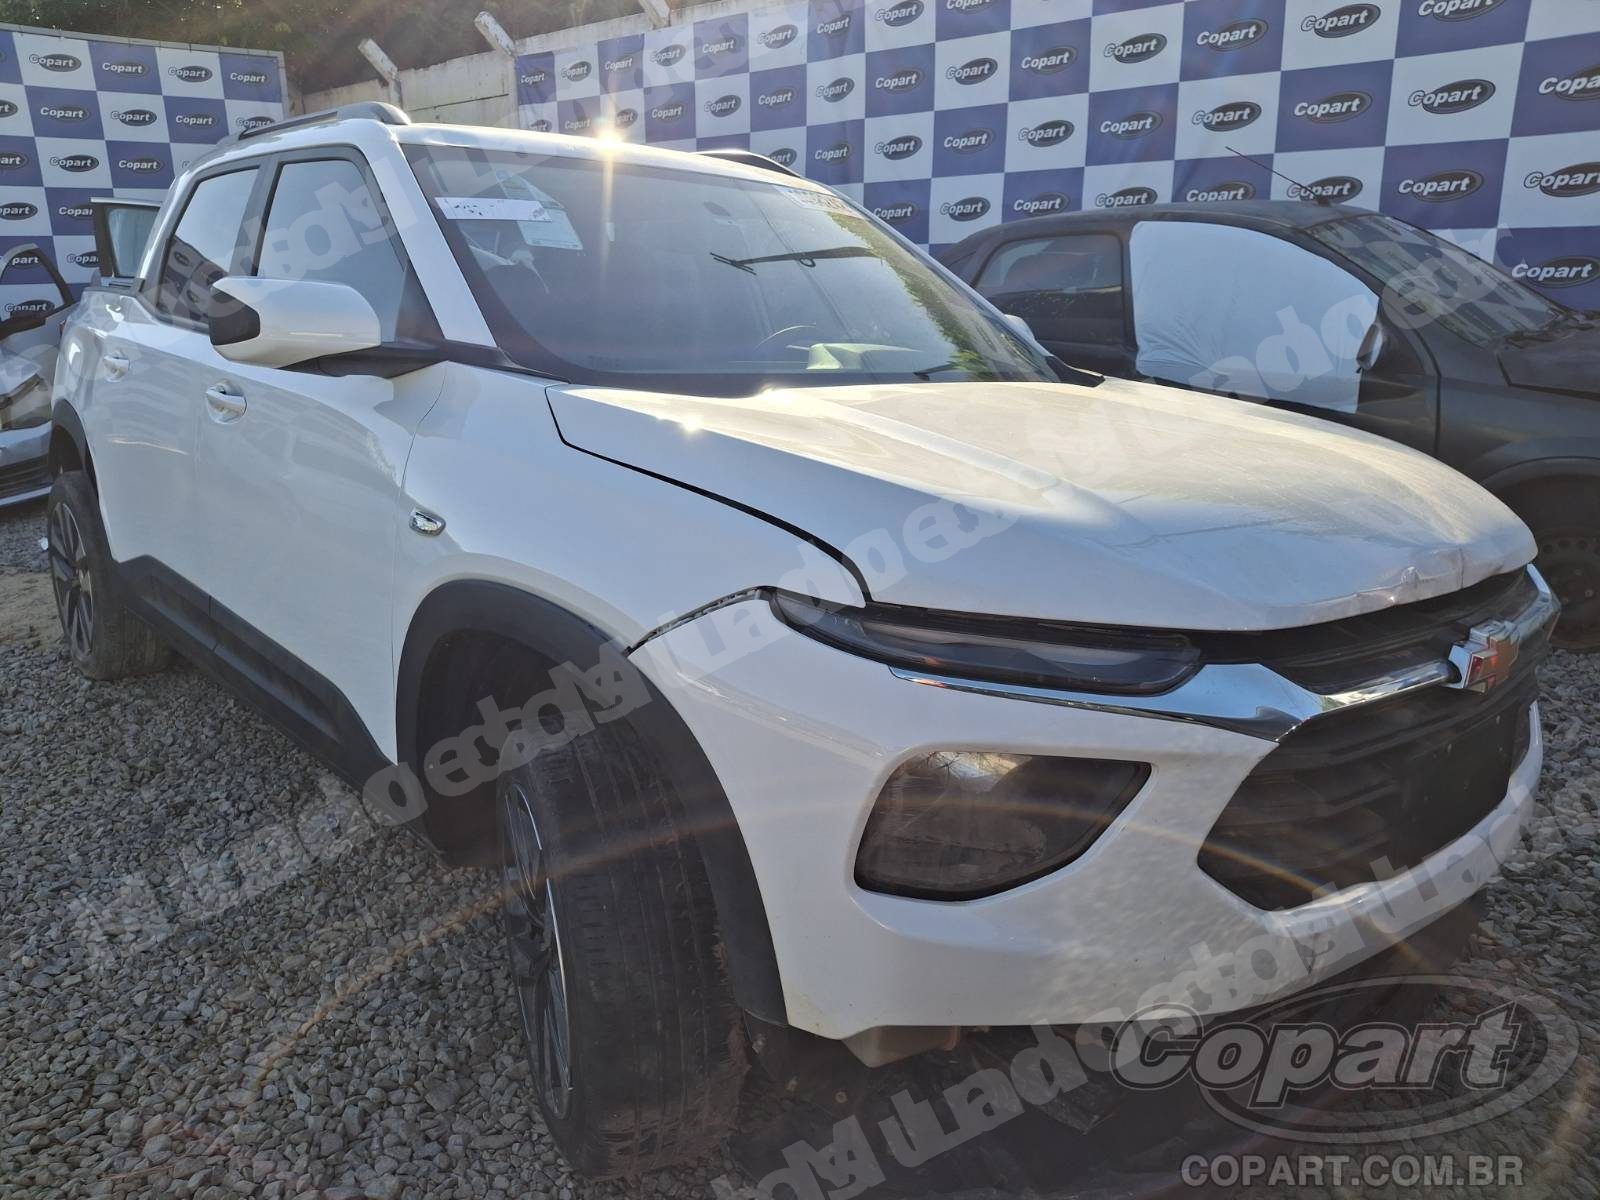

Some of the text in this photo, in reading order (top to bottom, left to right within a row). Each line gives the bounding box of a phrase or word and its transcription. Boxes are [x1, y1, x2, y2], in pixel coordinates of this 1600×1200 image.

[875, 4, 918, 21] Copart
[816, 17, 849, 34] Copart
[1301, 9, 1368, 32] Copart
[758, 29, 792, 45] Copart
[1197, 25, 1256, 46] Copart
[703, 39, 735, 54] Copart
[1104, 38, 1158, 57] Copart
[29, 54, 74, 67] Copart
[102, 62, 143, 74] Copart
[1021, 52, 1070, 69] Copart
[168, 66, 206, 78] Copart
[230, 72, 265, 82] Copart
[946, 62, 990, 79] Copart
[875, 73, 917, 89] Copart
[1538, 77, 1600, 95] Copa
[816, 82, 848, 97] Copart
[1407, 86, 1482, 107] Copart
[704, 98, 736, 113] Copart
[758, 92, 792, 105] Copart
[40, 107, 83, 118] Copart
[652, 106, 682, 119] Copart
[1294, 98, 1360, 117] Copart
[111, 111, 150, 122] Copart
[176, 115, 213, 125] Copart
[1192, 108, 1250, 125] Copart
[1100, 117, 1153, 133] Copart
[944, 133, 987, 148] Copart
[1018, 125, 1066, 141] Copart
[815, 147, 848, 160] Copart
[874, 140, 915, 154] Copart
[0, 156, 21, 165] art
[50, 157, 92, 167] Copart
[118, 160, 158, 171] Copart
[1399, 177, 1470, 196] Copart
[1523, 170, 1600, 190] Copar
[1186, 187, 1245, 201] Copart
[1288, 180, 1350, 198] Copart
[1014, 198, 1061, 213] Copart
[1096, 193, 1148, 208] Copart
[0, 206, 30, 216] part
[873, 206, 912, 219] Copart
[940, 201, 983, 216] Copart
[12, 256, 39, 266] part
[1512, 263, 1593, 281] Copart
